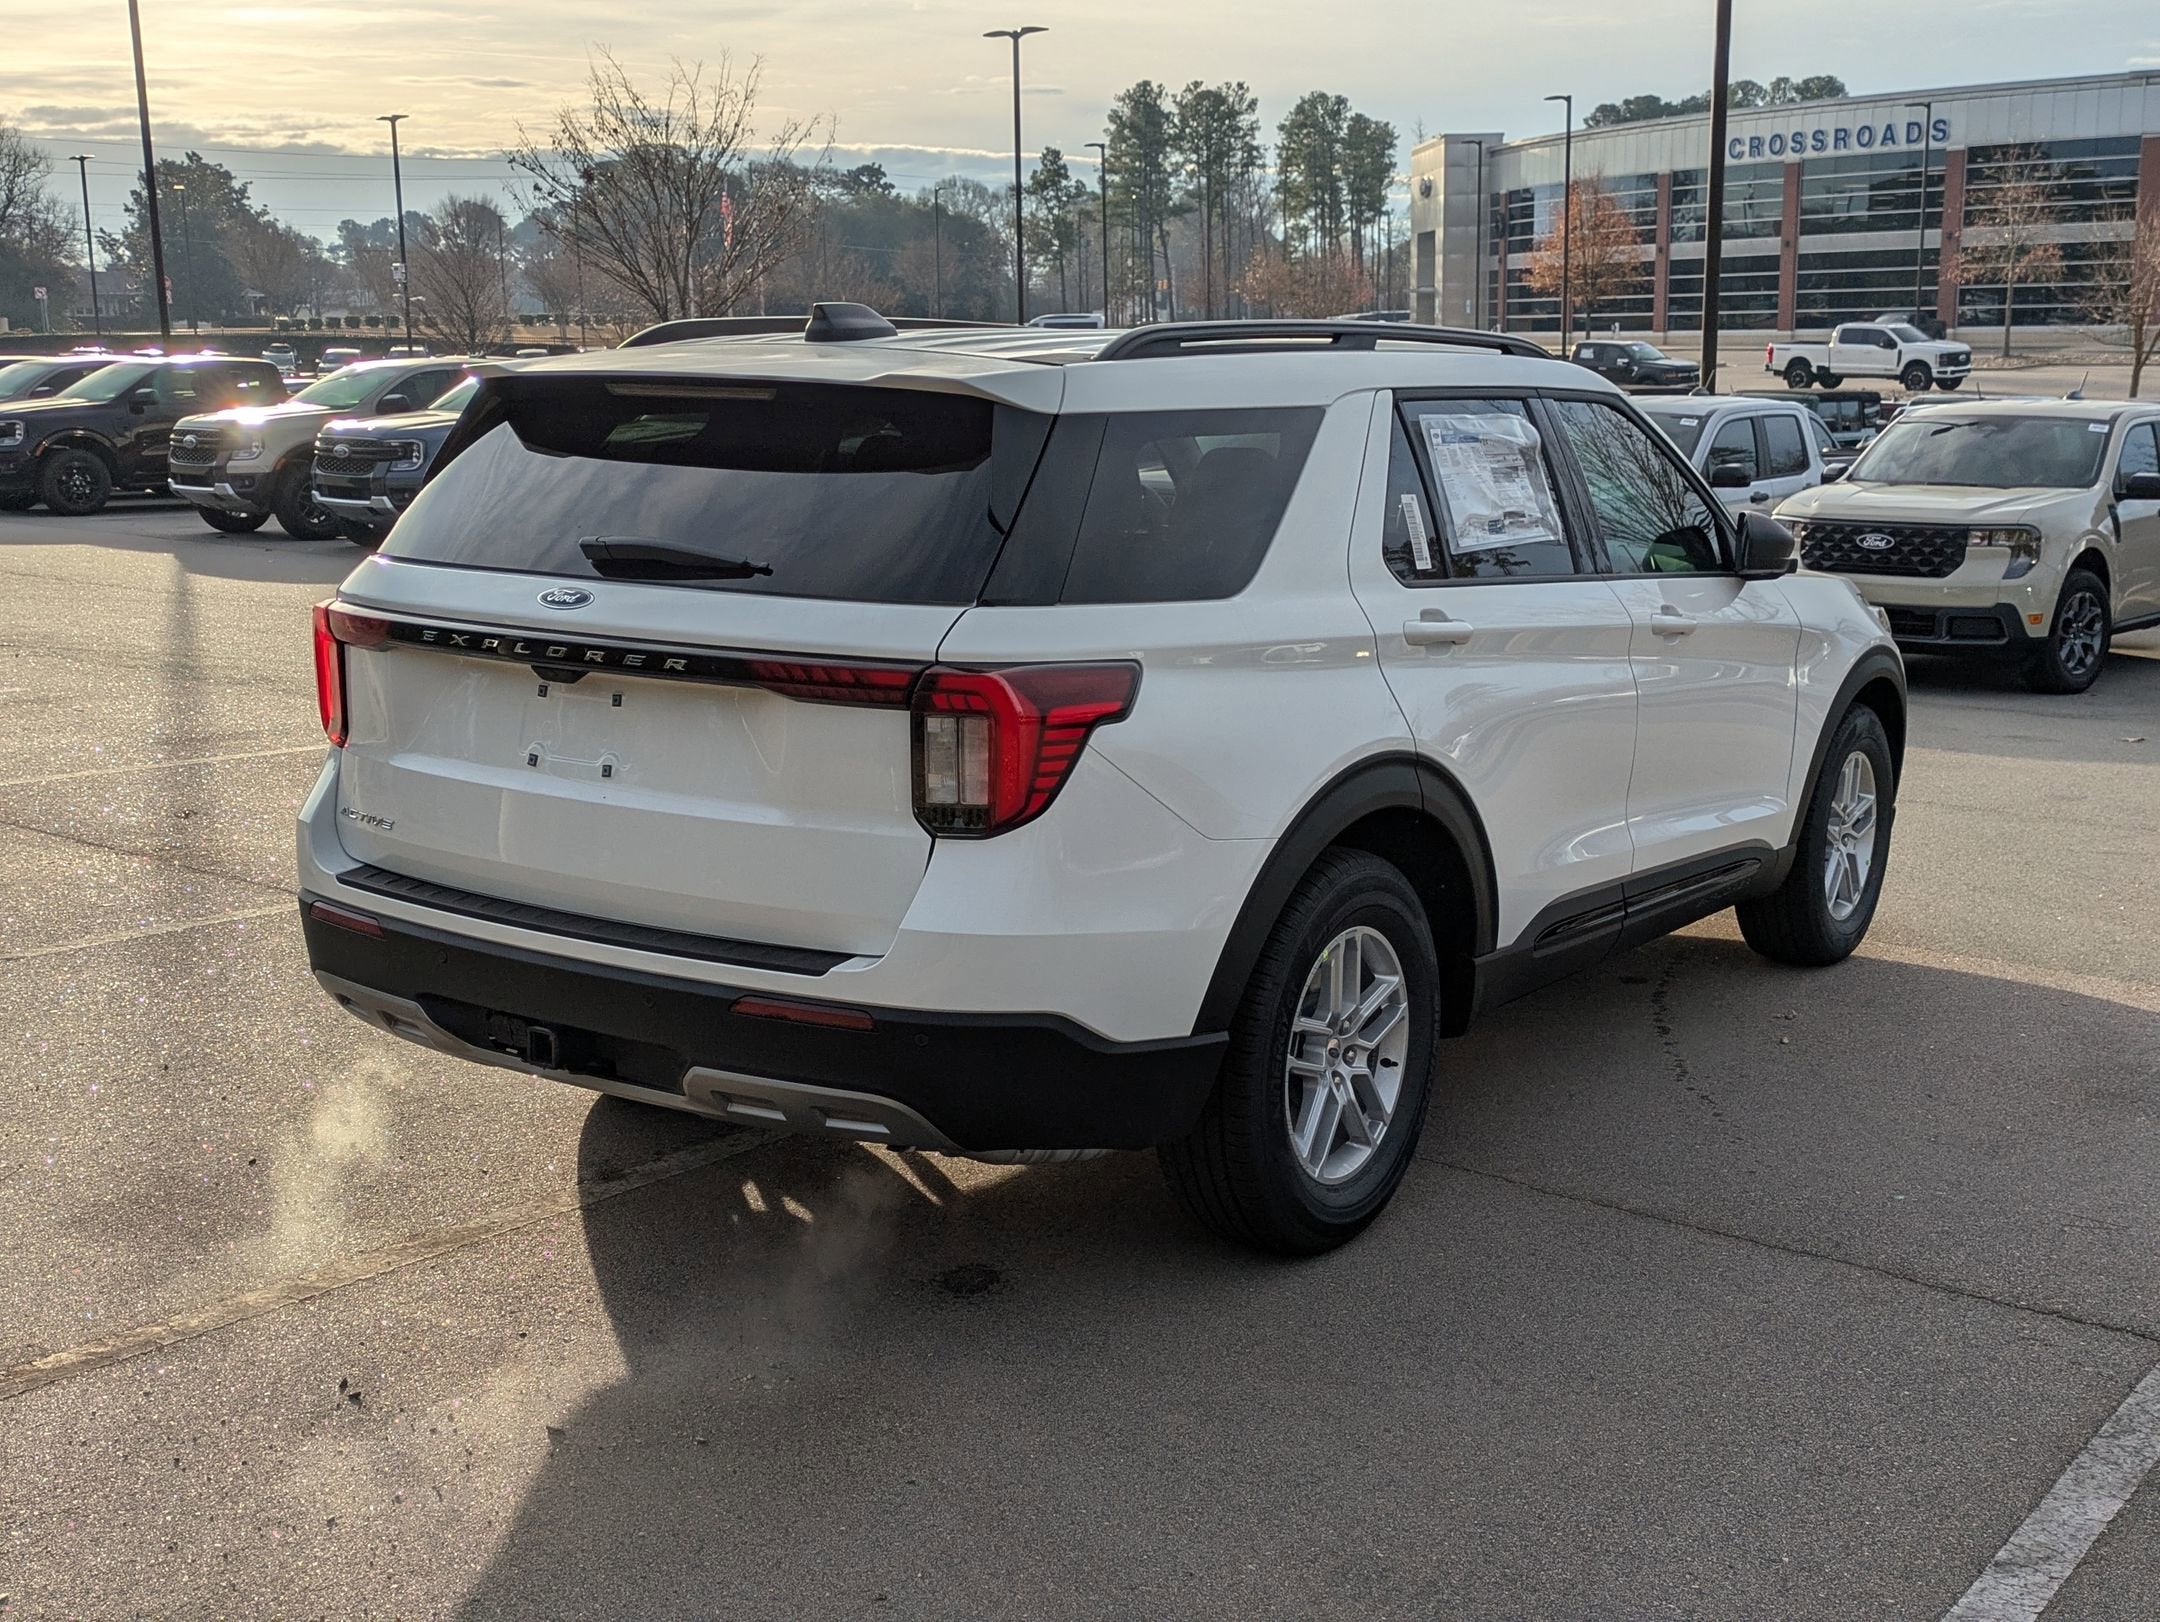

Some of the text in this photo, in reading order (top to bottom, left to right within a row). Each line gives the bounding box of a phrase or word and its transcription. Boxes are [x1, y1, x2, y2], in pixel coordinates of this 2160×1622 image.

[1728, 118, 1949, 160] CROSSROADS
[421, 630, 689, 671] EXPLORER
[340, 806, 395, 831] ACTIVE
